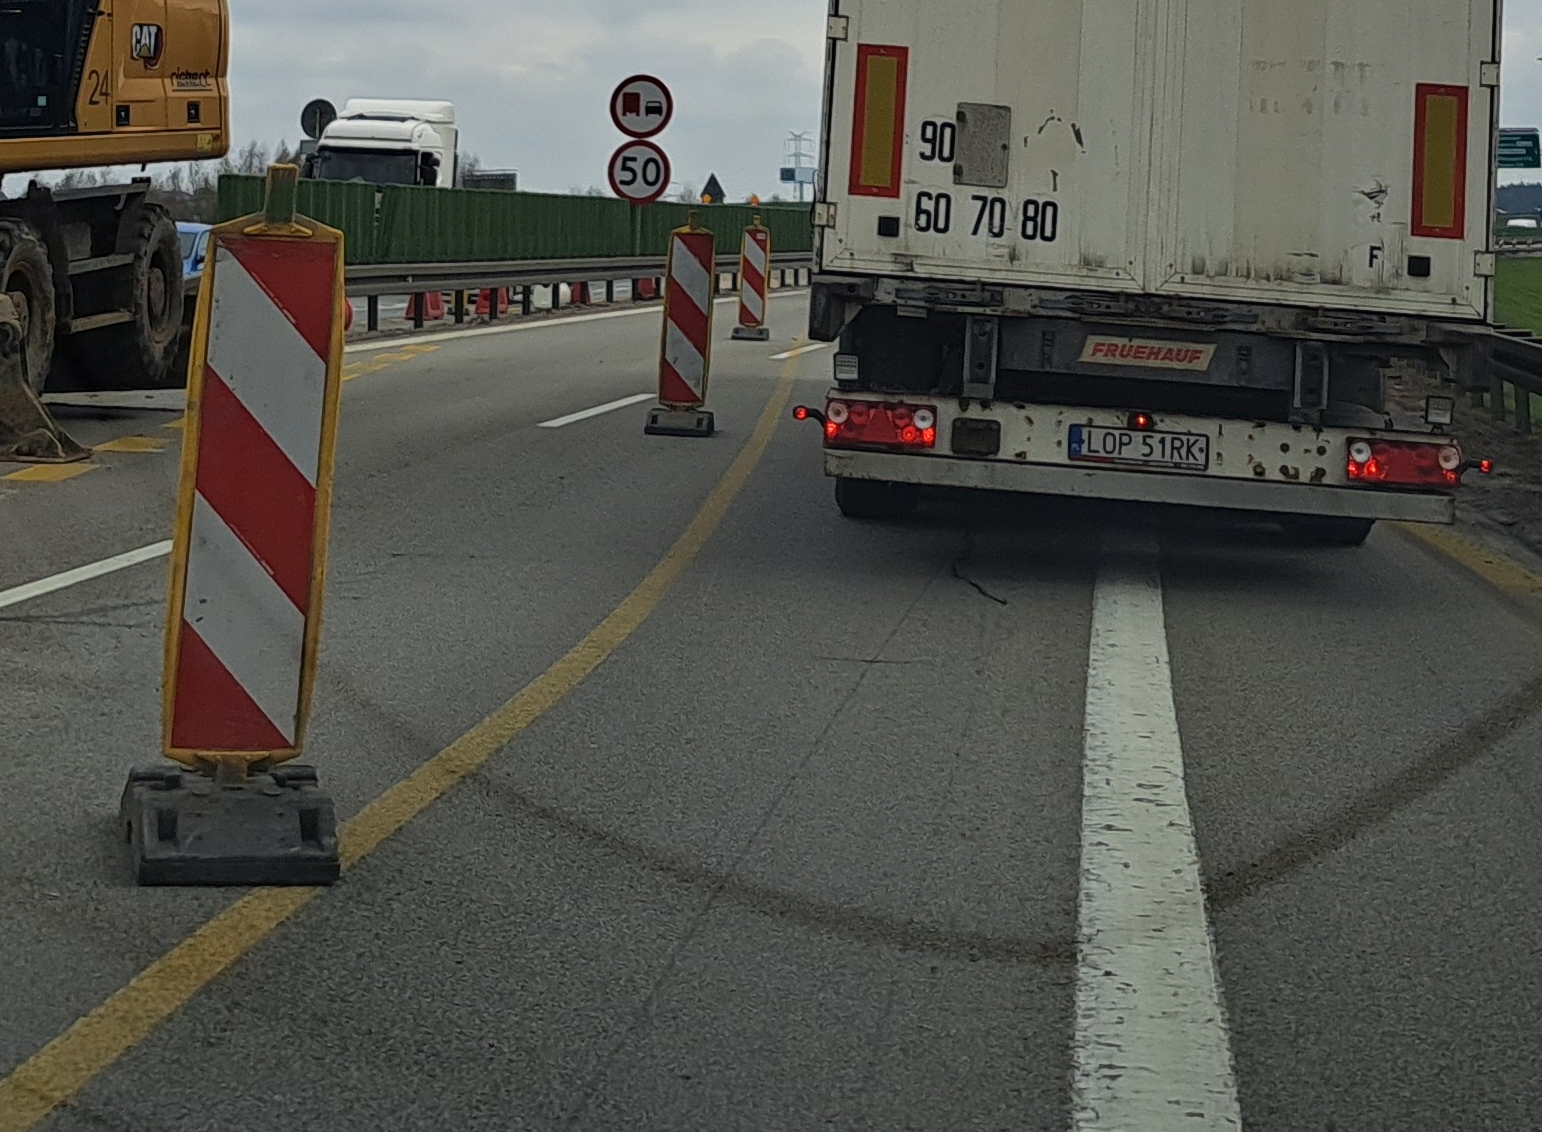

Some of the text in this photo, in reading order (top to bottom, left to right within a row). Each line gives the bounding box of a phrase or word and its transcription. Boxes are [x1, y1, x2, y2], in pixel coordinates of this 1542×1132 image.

[132, 24, 158, 60] CAT
[88, 69, 110, 105] 24
[919, 120, 956, 163] 90
[619, 156, 661, 187] 50
[915, 191, 1058, 242] 60 70 80
[1090, 342, 1204, 364] FRUEHAUF
[1087, 430, 1200, 462] LOP 51RK
